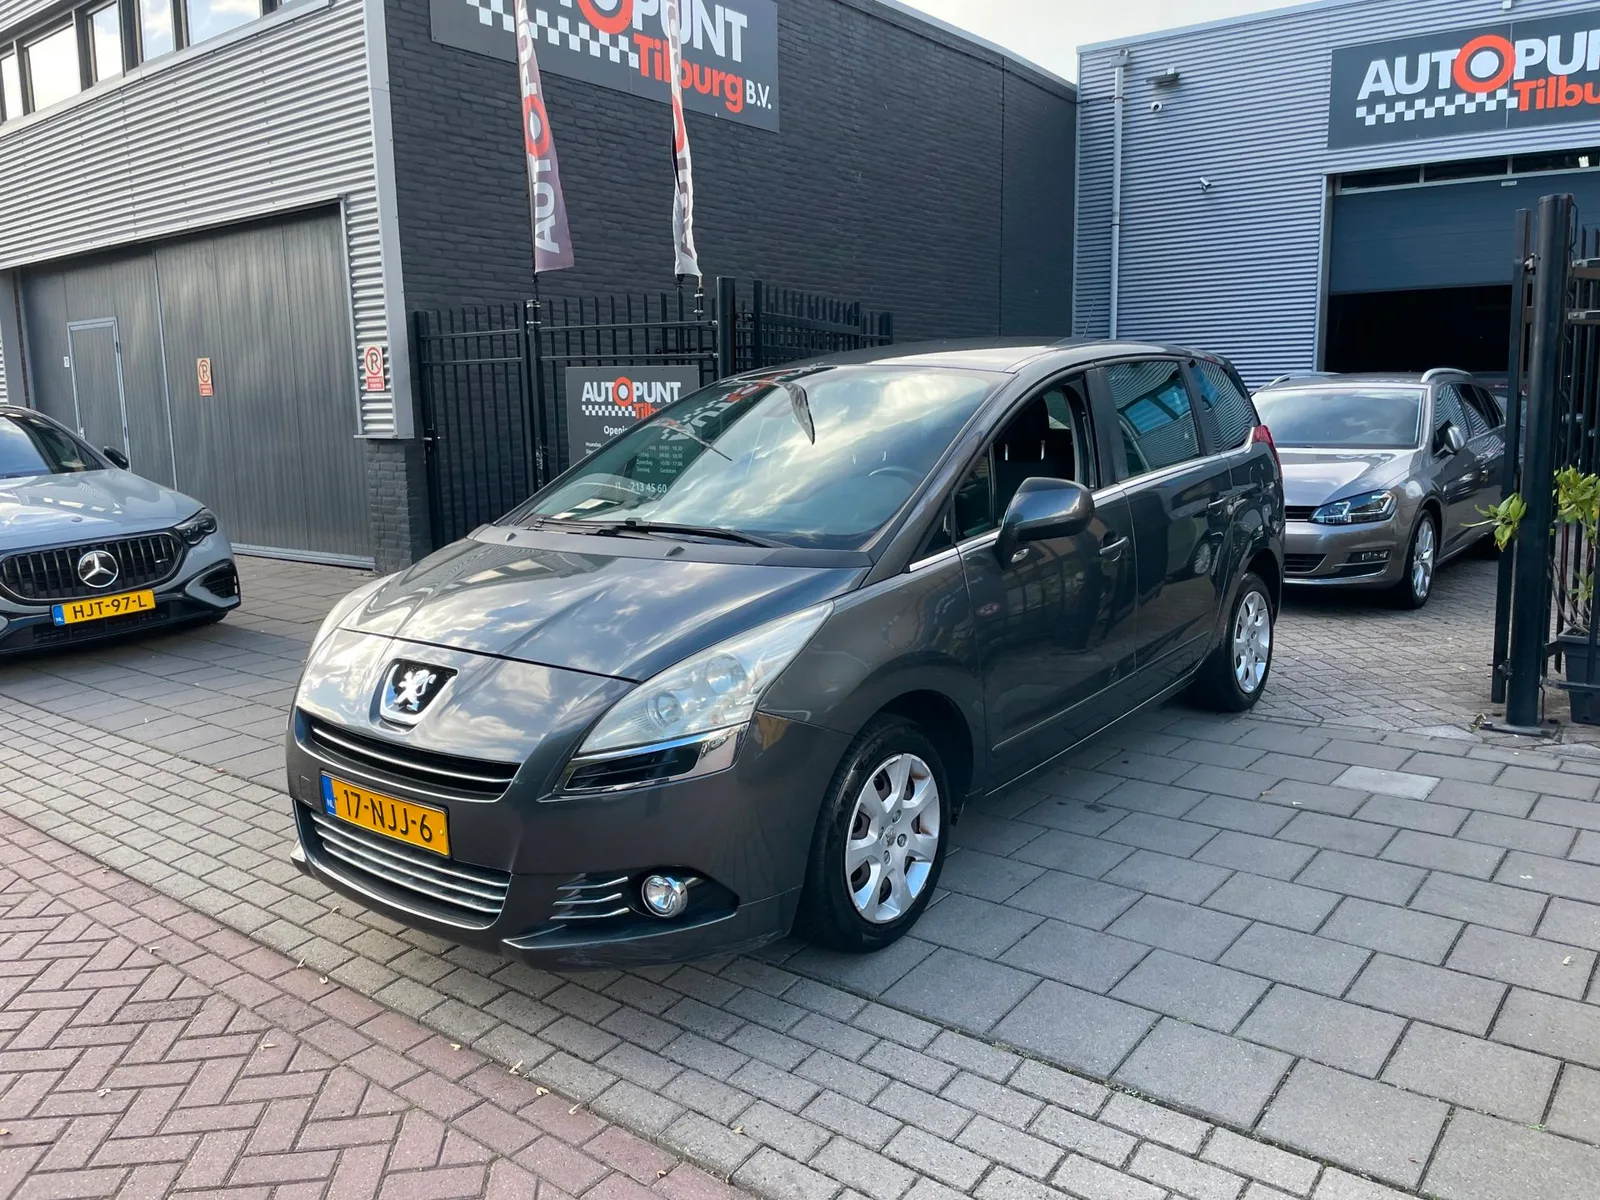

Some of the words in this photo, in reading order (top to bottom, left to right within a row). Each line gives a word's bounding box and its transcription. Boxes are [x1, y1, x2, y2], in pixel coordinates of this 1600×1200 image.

[746, 79, 772, 110] B.V.
[581, 376, 682, 407] AUTOPUNT
[633, 402, 660, 419] Tilb
[73, 594, 147, 619] HJT-97-L
[326, 796, 335, 809] NL
[343, 789, 433, 844] 17-NJJ-6
